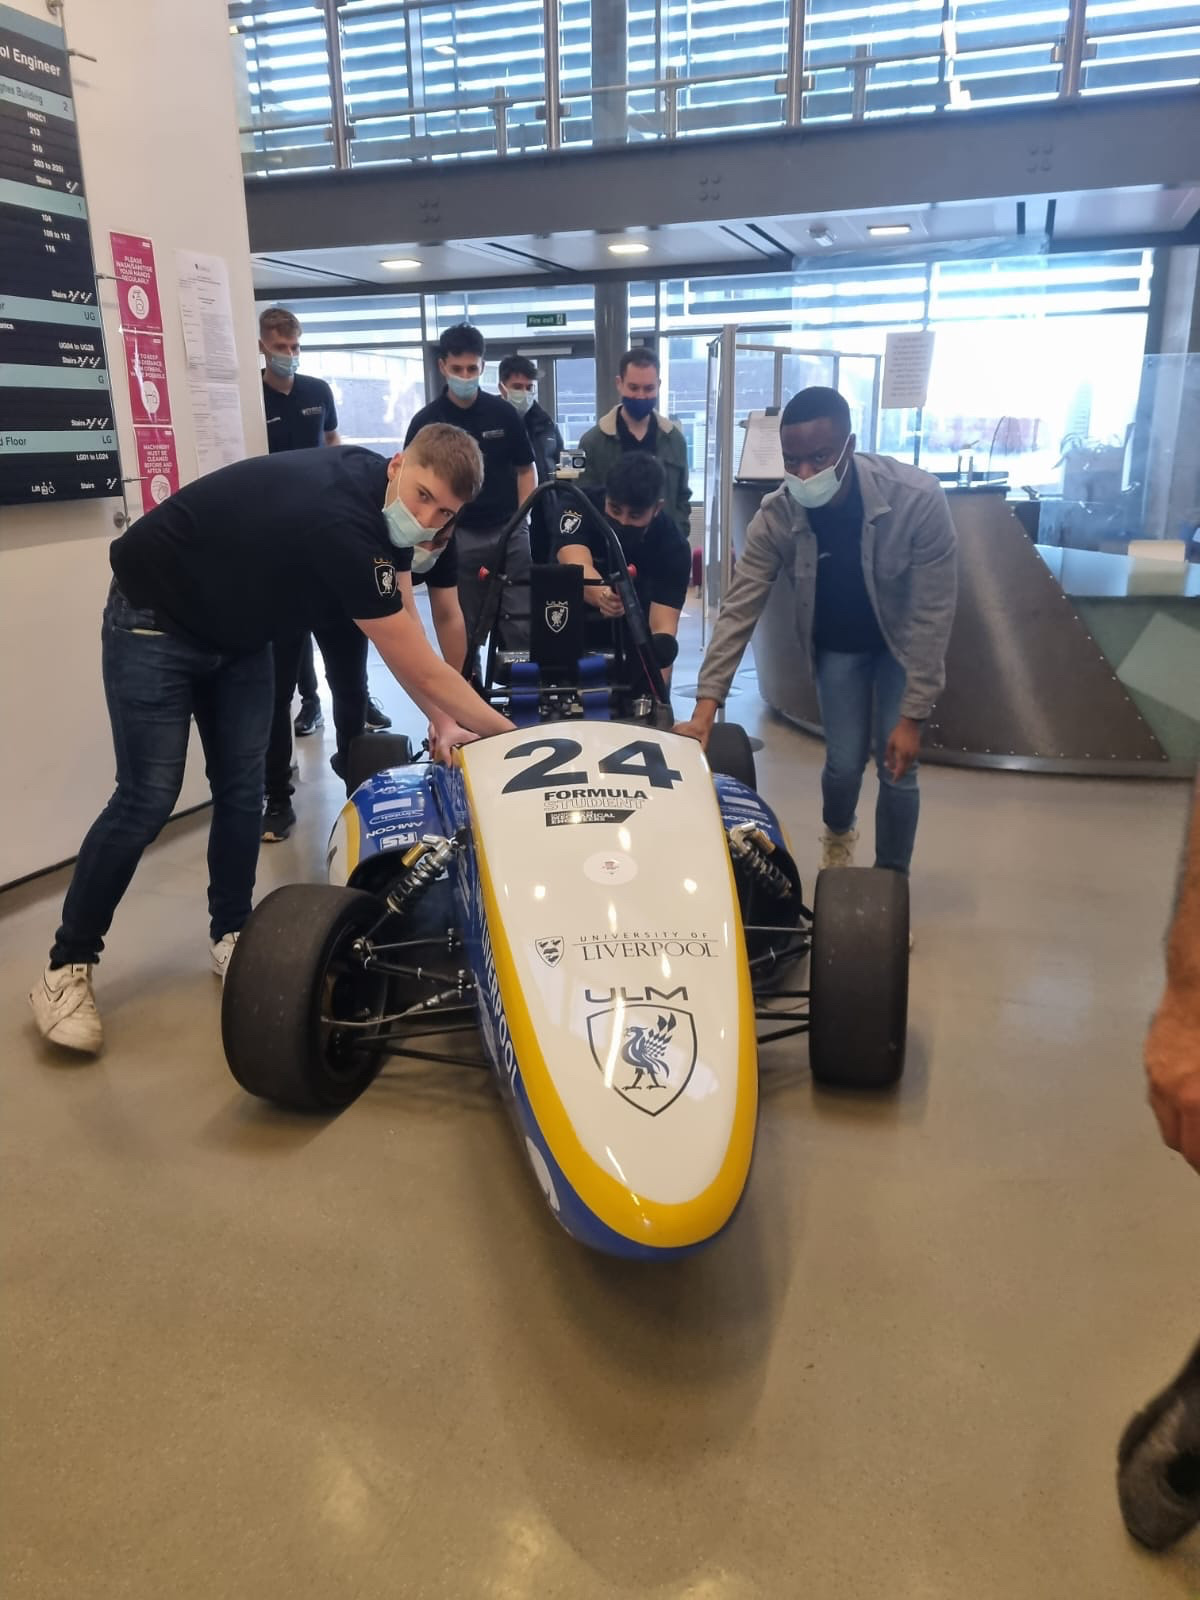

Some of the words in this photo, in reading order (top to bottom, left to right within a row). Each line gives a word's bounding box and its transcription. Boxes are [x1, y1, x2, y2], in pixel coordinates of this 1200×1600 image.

[13, 48, 61, 76] Engineer
[63, 101, 69, 112] 2
[124, 255, 142, 264] PLEASE
[51, 289, 67, 299] Stairs
[83, 311, 96, 321] UG
[62, 356, 77, 364] Stairs
[98, 375, 105, 384] G
[71, 419, 86, 427] Stairs
[6, 436, 27, 446] Floor
[102, 435, 112, 444] LG
[502, 738, 683, 794] 24
[544, 789, 649, 801] FORMULA
[544, 798, 646, 811] STUDENT
[580, 931, 679, 942] UNIVERSITY
[582, 941, 719, 960] LIVERPOOL
[584, 986, 688, 1003] ULM
